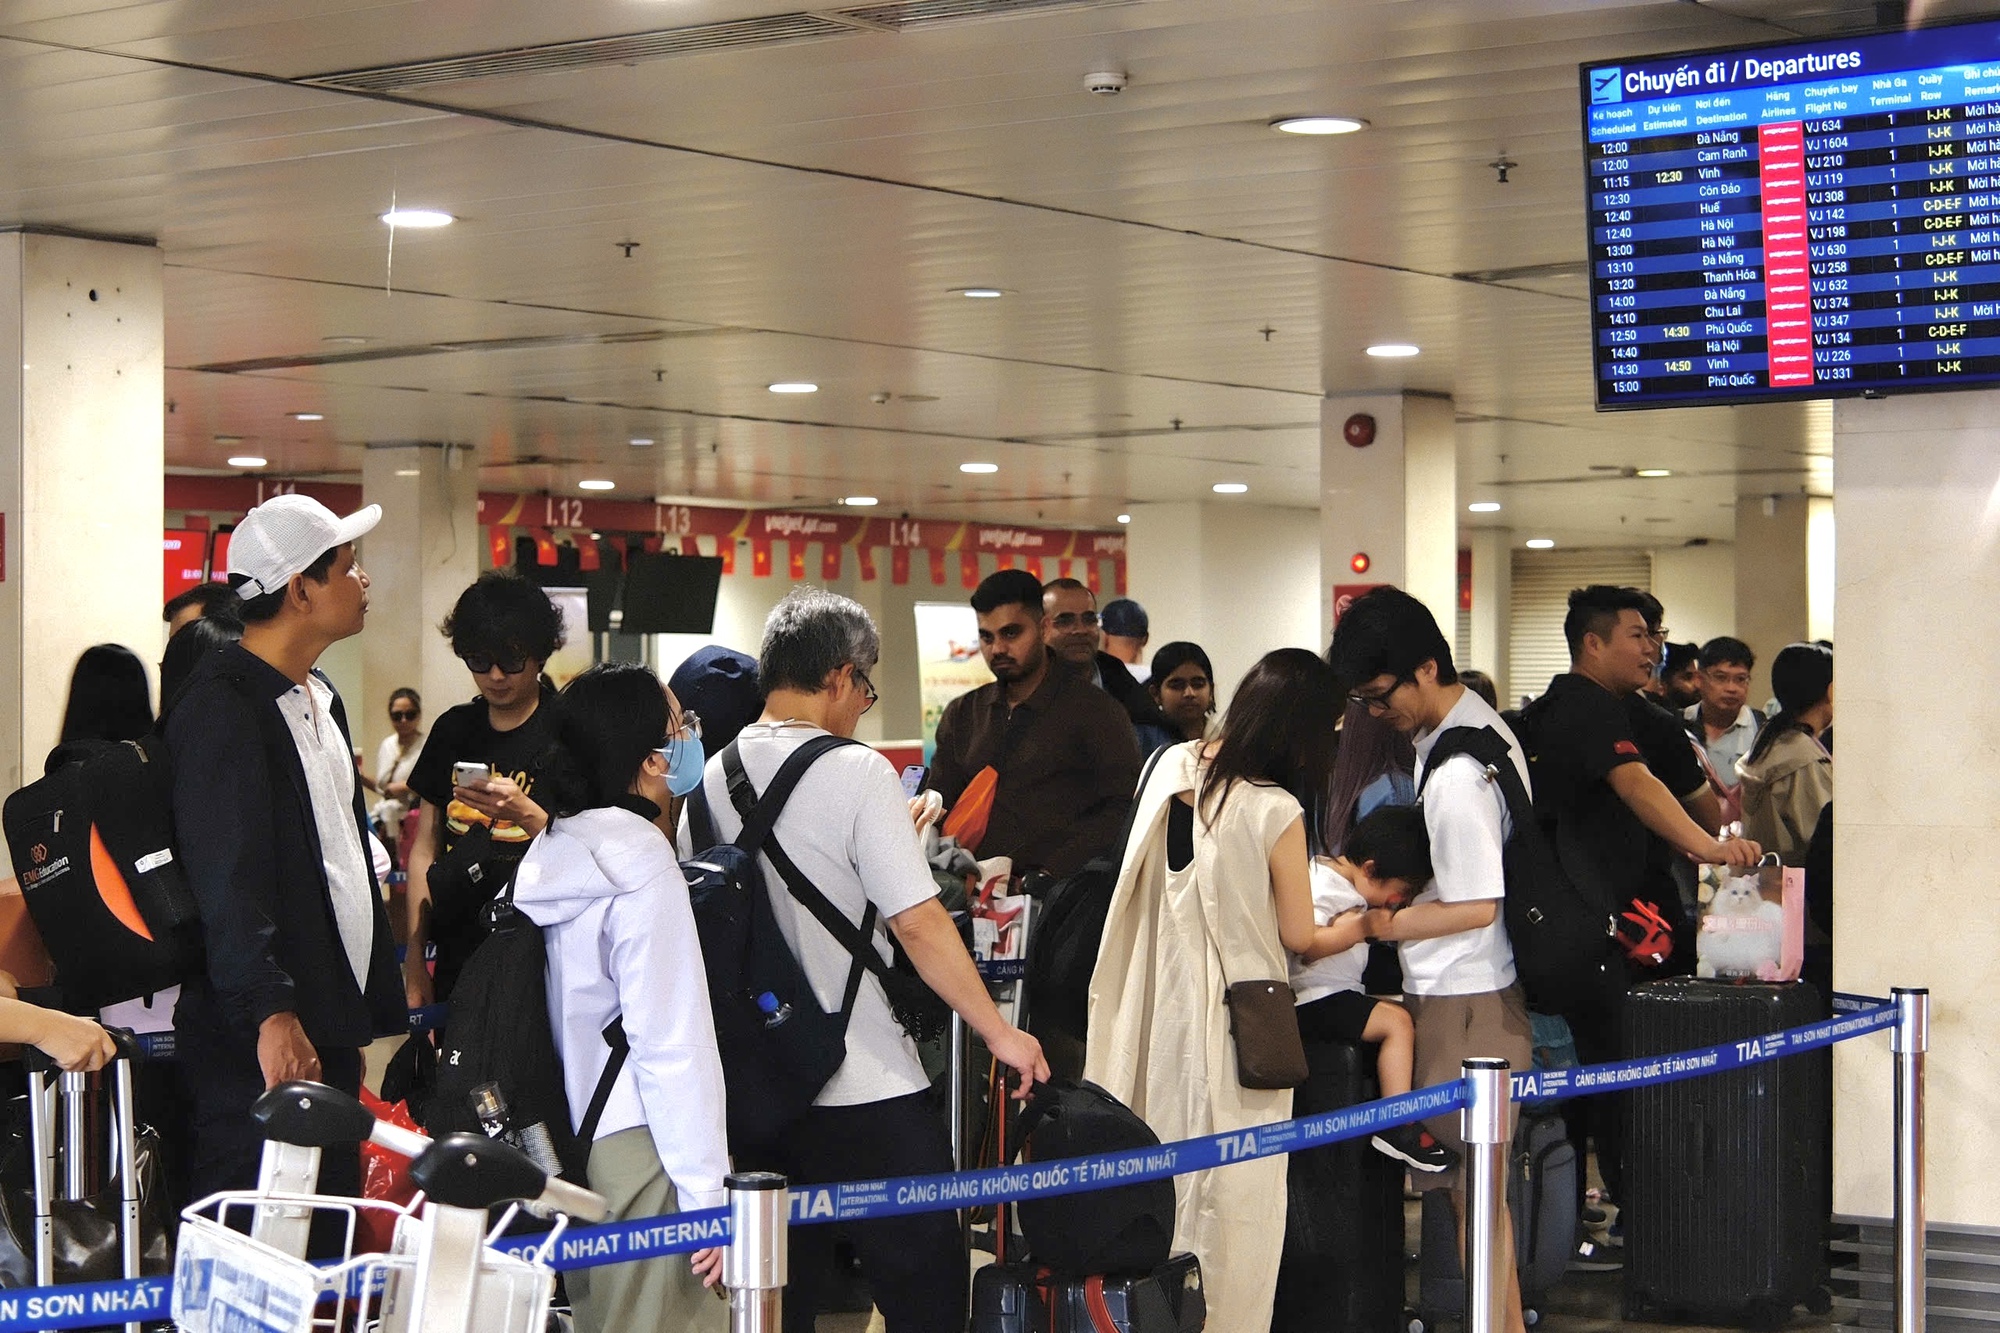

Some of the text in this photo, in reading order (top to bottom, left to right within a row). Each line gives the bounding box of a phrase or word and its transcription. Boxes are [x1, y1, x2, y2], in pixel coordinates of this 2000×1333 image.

[1625, 51, 1861, 93] Chuyến đi / Departures
[1872, 78, 1907, 90] Nhà Ga
[1842, 84, 1858, 94] bay
[1870, 94, 1912, 106] Terminal
[1920, 92, 1942, 100] Row
[1696, 112, 1747, 125] Destination
[1762, 107, 1796, 118] Airlines
[1805, 102, 1847, 114] Flight No
[1591, 124, 1636, 136] Scheduled
[1602, 142, 1628, 154] 12:00
[1696, 133, 1710, 145] Đà
[1806, 122, 1820, 134] VJ
[1822, 120, 1842, 132] 634
[1644, 118, 1688, 130] Estimated
[1602, 159, 1629, 172] 12:00
[1698, 151, 1720, 162] Cam
[1723, 148, 1748, 160] Ranh
[1806, 139, 1820, 151] VJ
[1823, 137, 1848, 149] 1604
[1603, 155, 1843, 189] 11:15 12:30 Vinh VJ 210
[1604, 193, 1630, 206] 12:30
[1700, 184, 1718, 196] Côn
[1808, 175, 1822, 186] VJ
[1824, 173, 1843, 185] 119
[1605, 210, 1631, 223] 12:40
[1809, 192, 1822, 204] VJ
[1825, 190, 1844, 202] 308
[1605, 227, 1632, 240] 12:40
[1701, 220, 1714, 231] Hà
[1809, 210, 1823, 222] VJ
[1825, 208, 1845, 220] 142
[1606, 244, 1633, 257] 13:00
[1702, 237, 1715, 248] Hà
[1810, 228, 1824, 239] VJ
[1826, 226, 1845, 238] 198
[1607, 261, 1634, 274] 13:10
[1702, 255, 1716, 266] Đà
[1811, 245, 1825, 257] VJ
[1827, 244, 1846, 256] 630
[1608, 261, 1847, 291] 13:20 Thanh Hóa VJ 258
[1609, 295, 1635, 308] 14:00
[1704, 289, 1718, 300] Đà
[1813, 281, 1826, 292] VJ
[1829, 279, 1847, 291] 632
[1609, 297, 1848, 325] 14:10 Chu Lai VJ 374
[1610, 329, 1637, 342] 12:50
[1663, 326, 1690, 338] 14:30
[1706, 324, 1724, 334] Phú
[1814, 316, 1828, 328] VJ
[1830, 314, 1849, 326] 347
[1611, 346, 1637, 359] 14:40
[1706, 341, 1720, 352] Hà
[1815, 334, 1828, 345] VJ
[1831, 332, 1849, 344] 134
[1612, 350, 1850, 376] 14:30 14:50 Vinh VJ 226
[1612, 380, 1639, 393] 15:00
[1708, 376, 1726, 387] Phú
[1816, 369, 1830, 380] VJ
[1832, 368, 1850, 380] 331
[1792, 1034, 1802, 1046] TAN
[1804, 1030, 1816, 1042] SON
[1816, 1026, 1832, 1039] NHAT
[1832, 1016, 1874, 1036] INTERNATIONAL
[1874, 1009, 1898, 1024] AIRPORT
[1736, 1040, 1762, 1062] TIA
[1575, 1072, 1596, 1088] CẢNG
[1596, 1068, 1616, 1084] HÀNG
[1617, 1065, 1642, 1082] KHÔNG
[1642, 1058, 1662, 1078] QUỐC
[1662, 1057, 1672, 1074] TẾ
[1672, 1056, 1686, 1072] TÂN
[1701, 1050, 1718, 1068] NHẤT
[1510, 1076, 1538, 1098] TIA
[1303, 1122, 1324, 1139] TAN
[1325, 1116, 1348, 1134] SON
[1349, 1109, 1376, 1128] NHAT
[1378, 1092, 1451, 1122] INTERNATIONAL
[1216, 1132, 1258, 1162] TIA
[842, 1182, 888, 1194] TAN SON NHAT
[897, 1148, 1178, 1205] CẢNG HÀNG KHÔNG QUỐC TẾ TÂN SƠN NHẤT
[787, 1190, 834, 1220] TIA
[840, 1194, 890, 1206] INTERNATIONAL
[840, 1207, 868, 1218] AIRPORT
[563, 1234, 621, 1260] NHAT
[26, 1293, 84, 1319] SƠN
[92, 1282, 164, 1313] NHẤT
